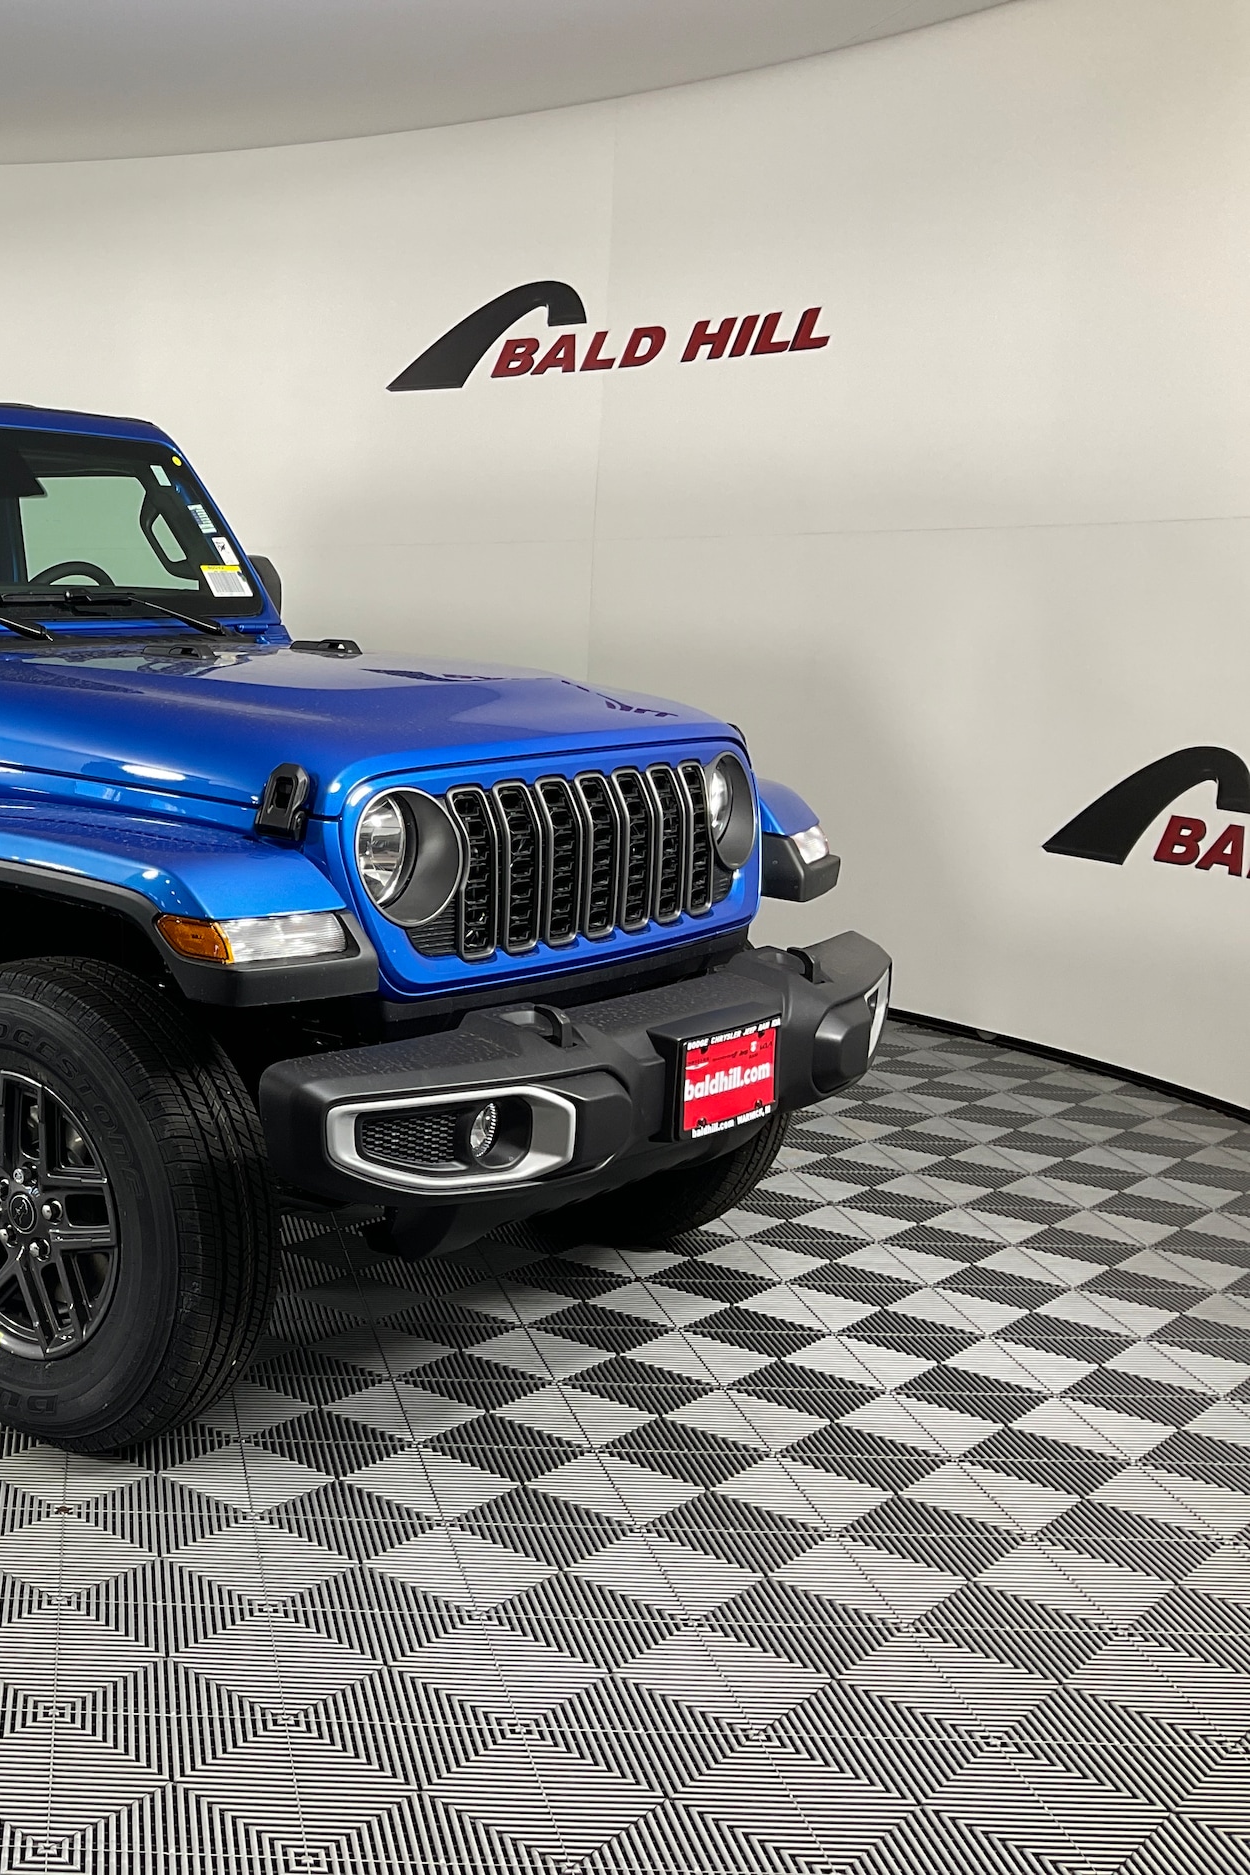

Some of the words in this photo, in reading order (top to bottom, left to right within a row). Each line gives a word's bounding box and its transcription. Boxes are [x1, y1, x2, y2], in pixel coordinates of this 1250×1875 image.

[490, 325, 667, 379] BALD
[680, 306, 831, 363] HILL
[1153, 815, 1250, 878] BA
[687, 1038, 710, 1051] DODGE
[711, 1030, 742, 1045] CHRYSLER
[742, 1025, 758, 1036] JEEP
[684, 1062, 770, 1101] baldhill.com
[692, 1119, 735, 1138] baldhill.com
